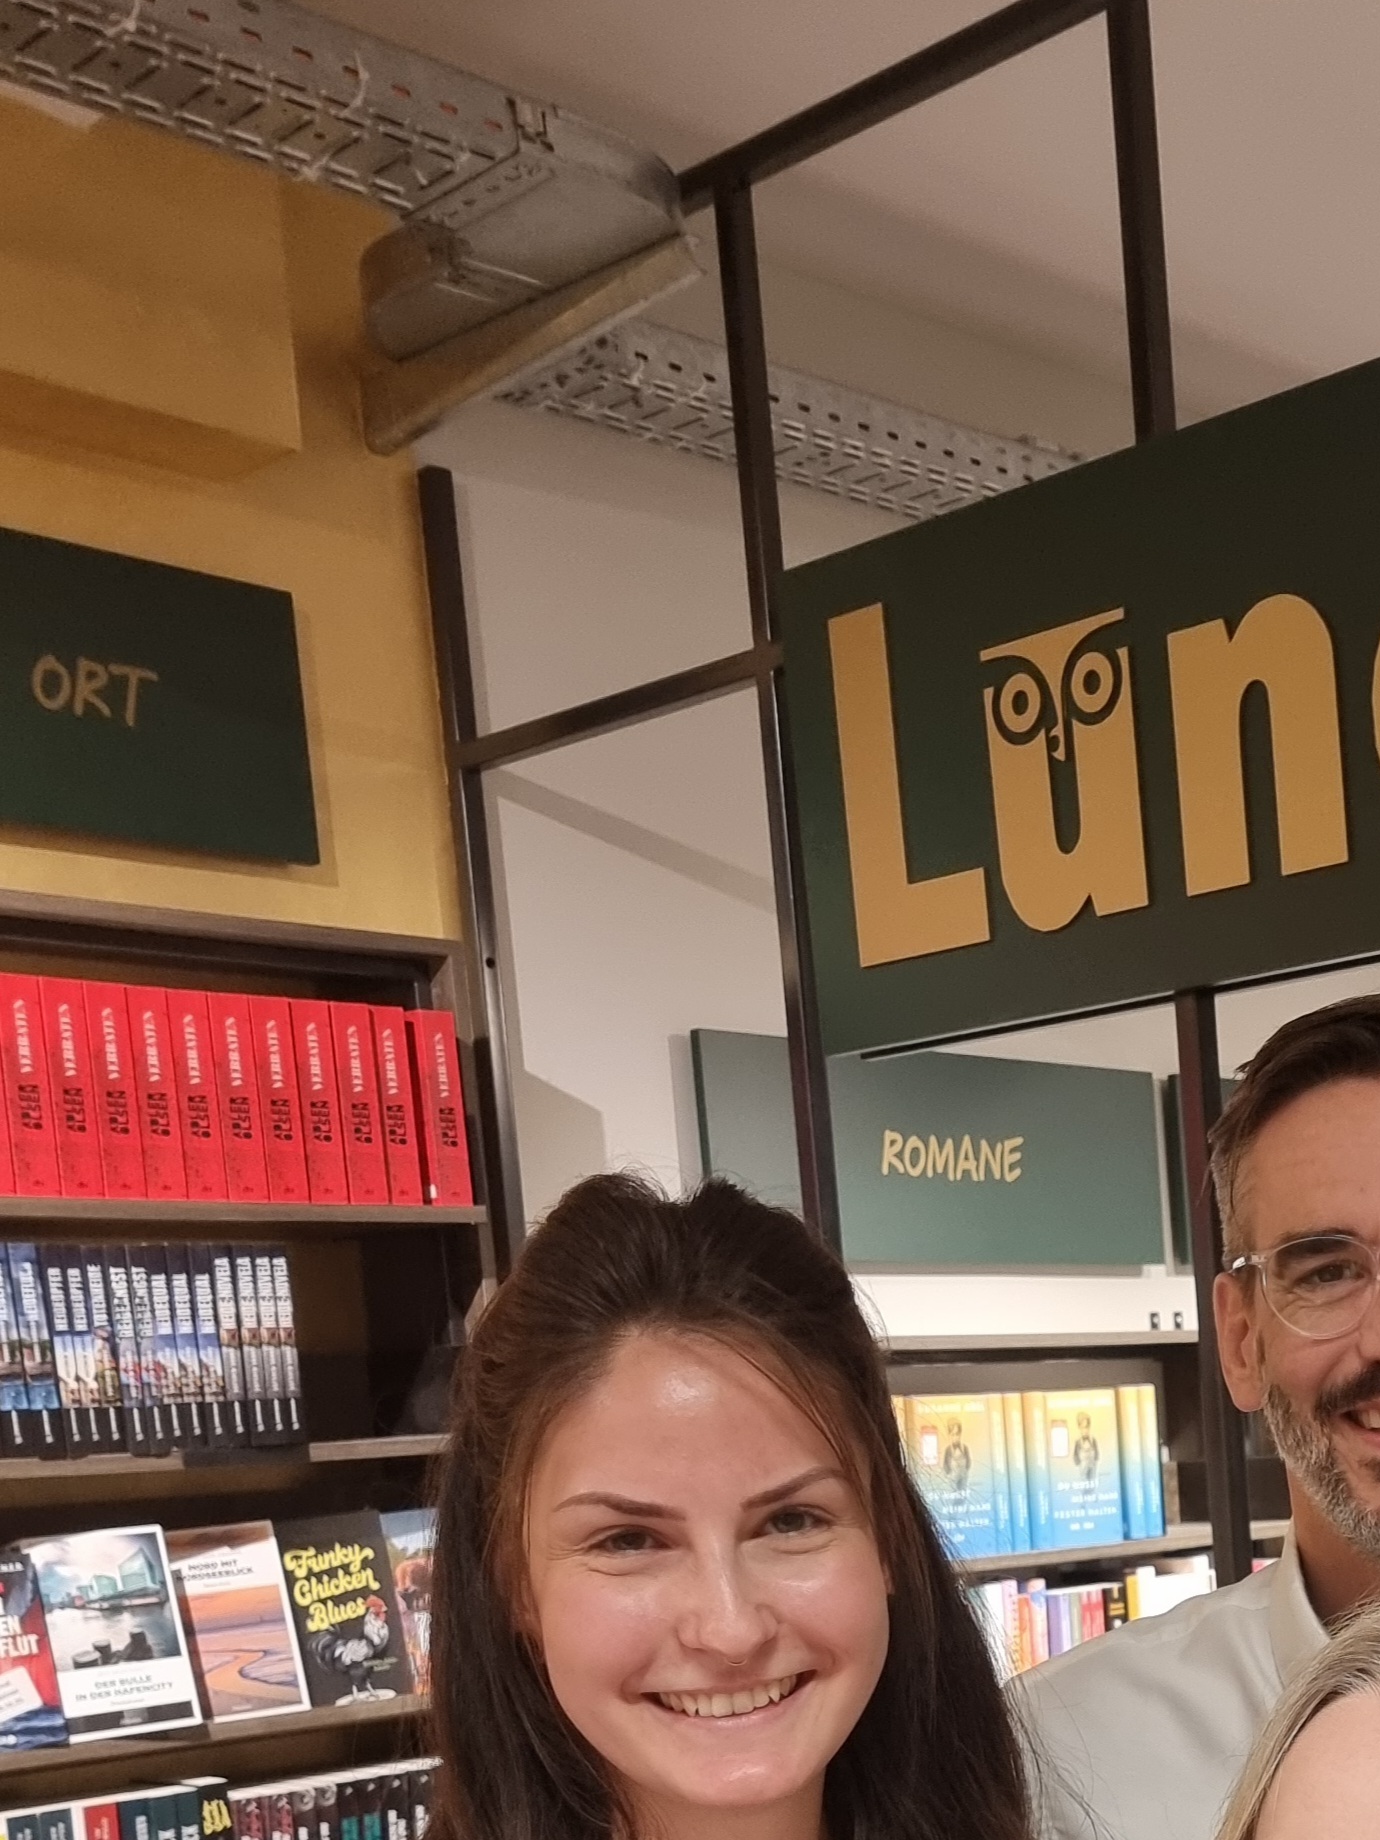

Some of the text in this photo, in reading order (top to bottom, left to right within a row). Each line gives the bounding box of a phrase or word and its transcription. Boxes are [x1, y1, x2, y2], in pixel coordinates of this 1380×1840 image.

[30, 652, 159, 727] ORT
[880, 1129, 1025, 1183] ROMANE
[283, 1542, 375, 1578] Funky
[293, 1566, 381, 1607] Chicken
[306, 1596, 367, 1633] Blues
